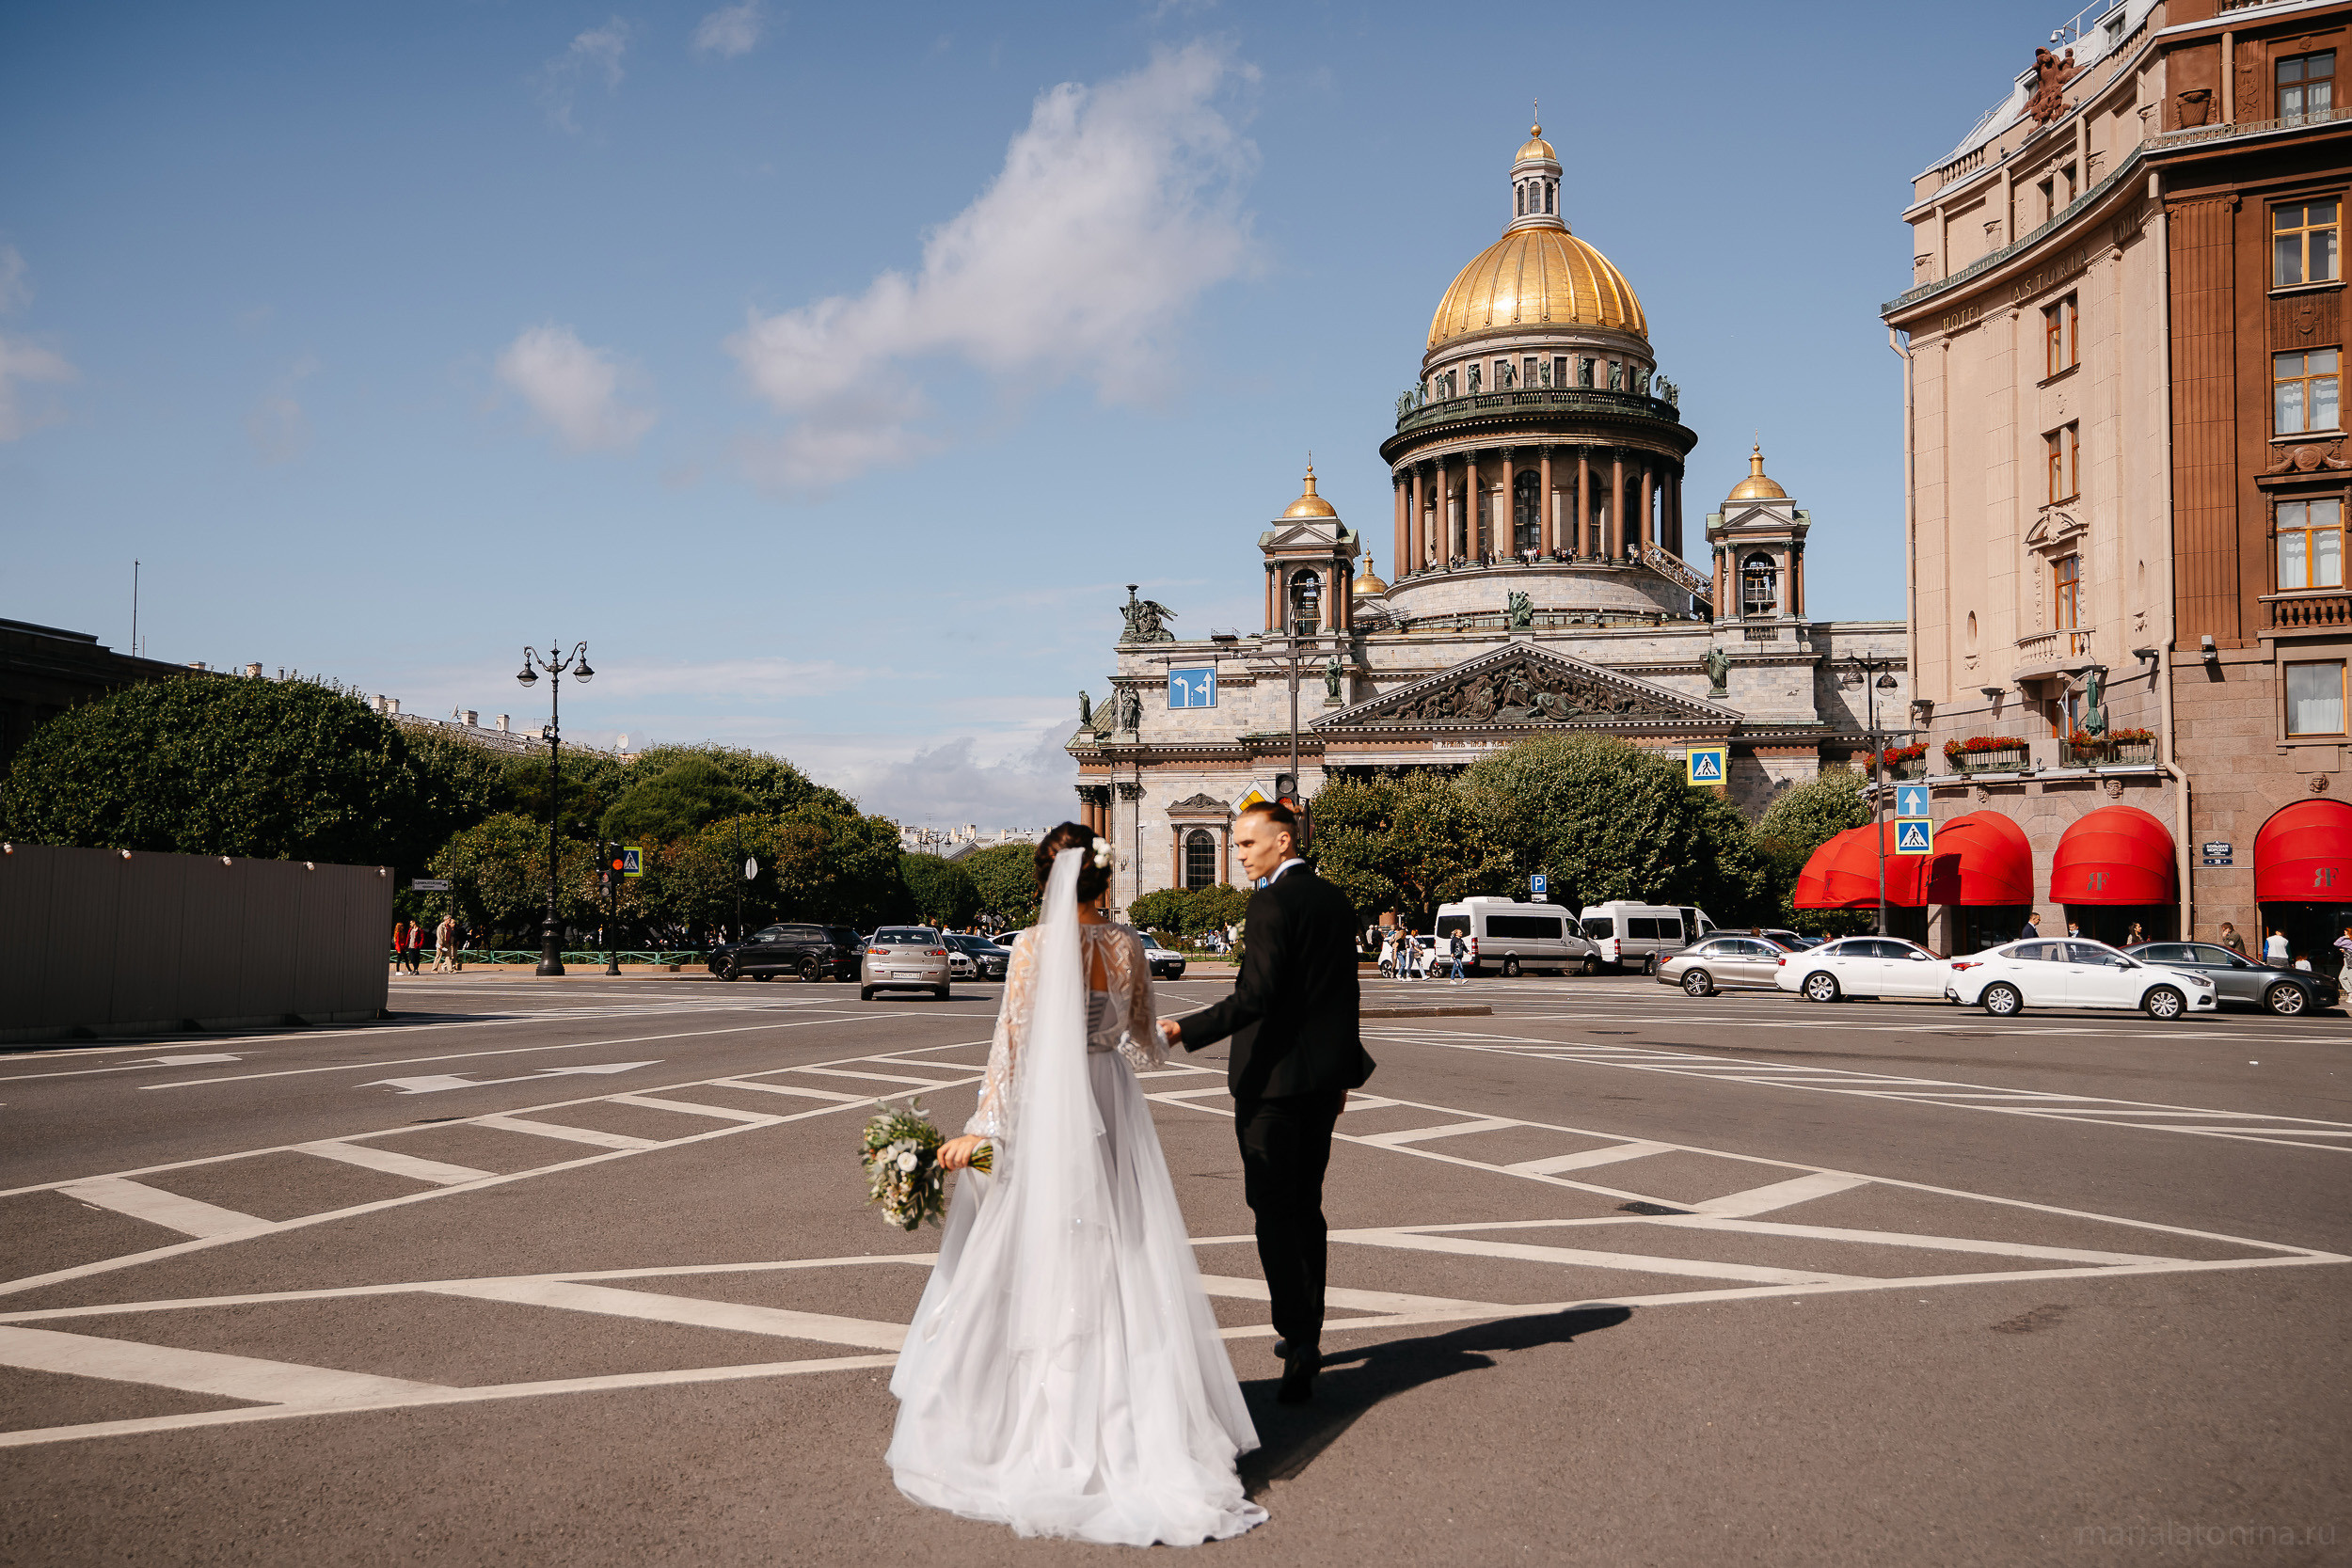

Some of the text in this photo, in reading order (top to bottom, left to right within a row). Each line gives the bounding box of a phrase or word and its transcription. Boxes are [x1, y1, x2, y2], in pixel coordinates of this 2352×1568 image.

[1943, 250, 2087, 334] HOTEL ASTORIA
[1534, 877, 1544, 890] P
